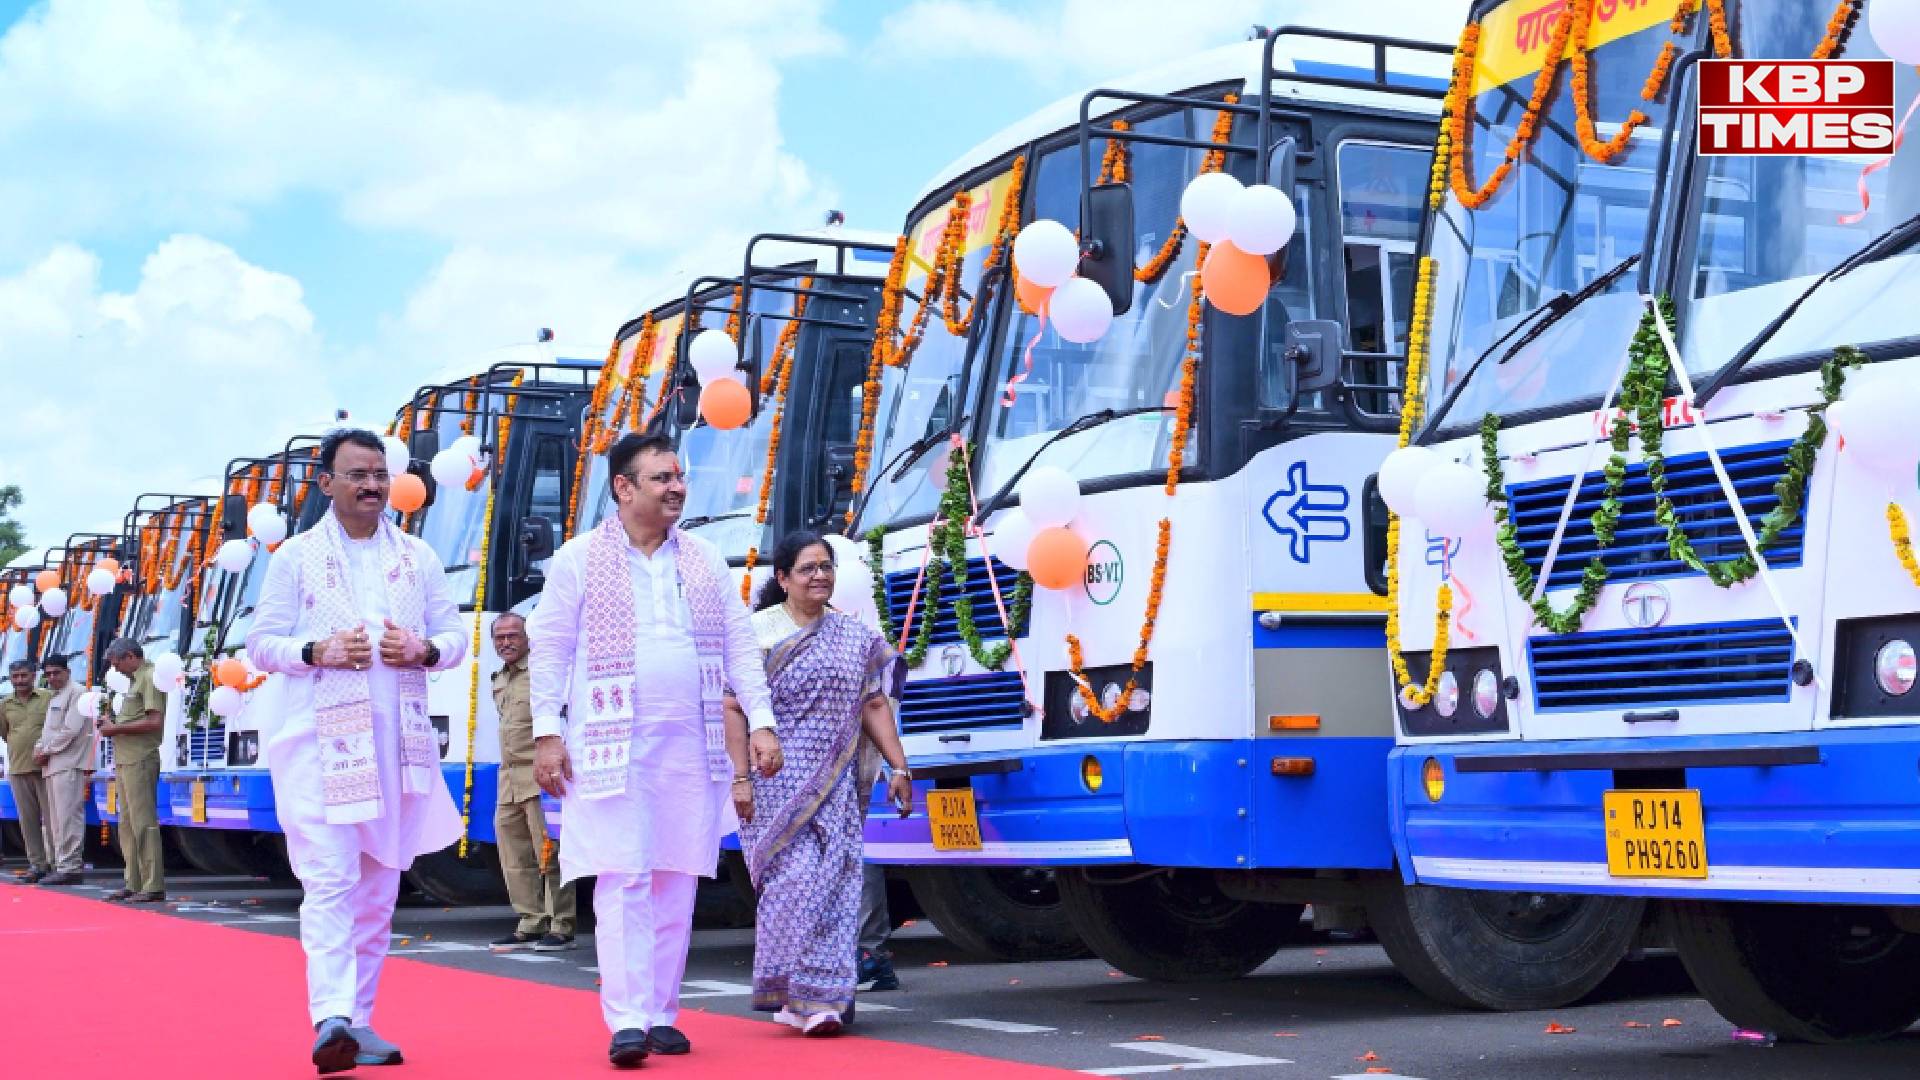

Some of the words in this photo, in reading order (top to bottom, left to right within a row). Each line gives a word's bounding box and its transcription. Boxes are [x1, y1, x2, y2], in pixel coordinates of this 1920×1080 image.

[941, 796, 967, 818] RJ14
[1632, 798, 1682, 830] RJ14
[1625, 840, 1700, 870] PH9260
